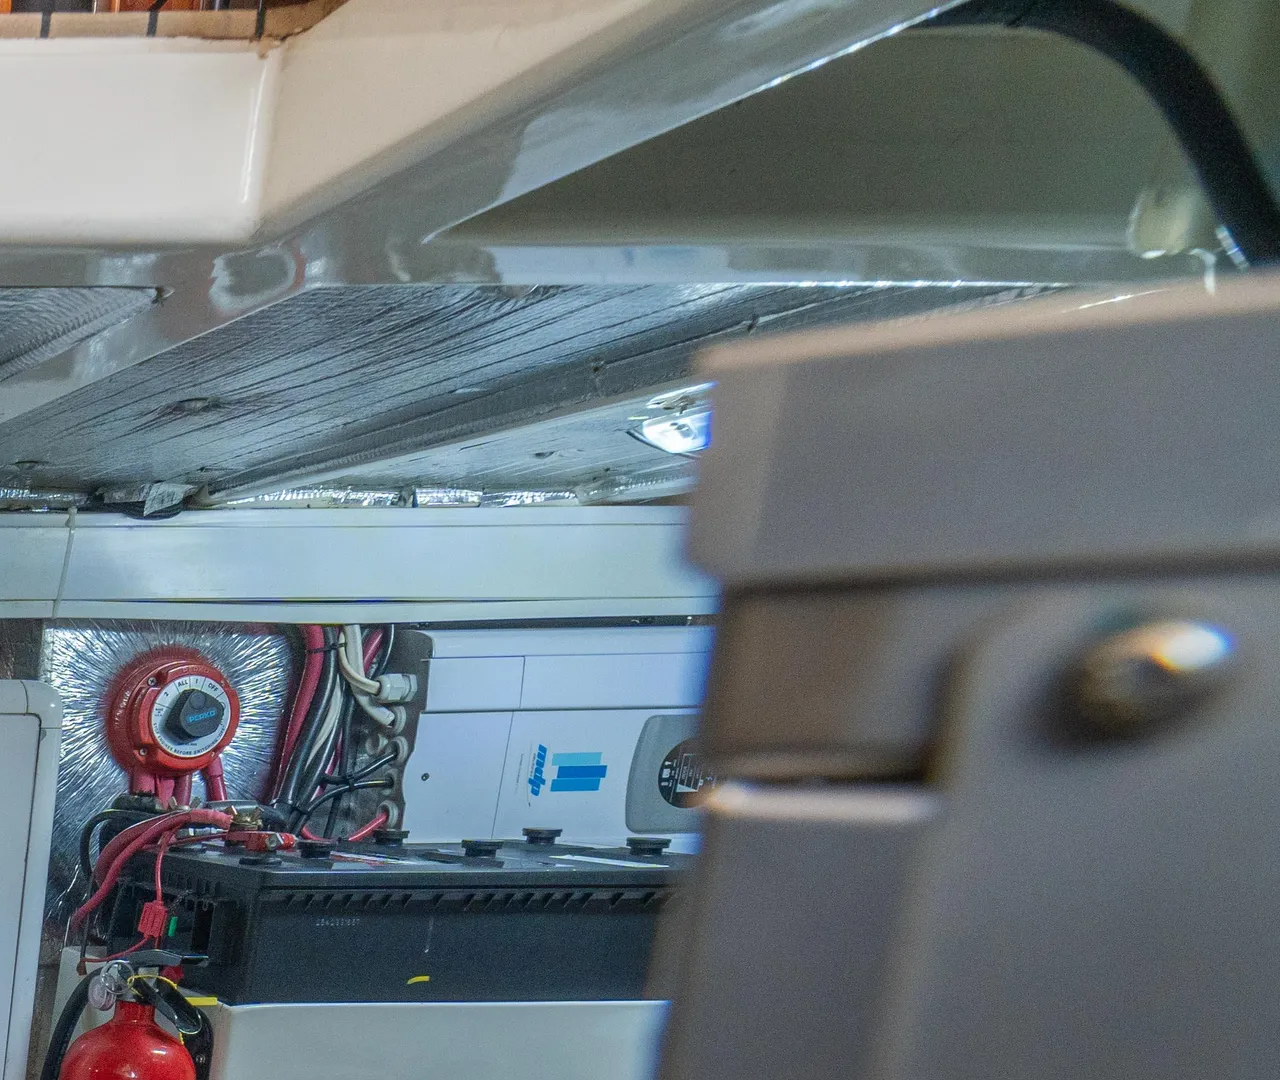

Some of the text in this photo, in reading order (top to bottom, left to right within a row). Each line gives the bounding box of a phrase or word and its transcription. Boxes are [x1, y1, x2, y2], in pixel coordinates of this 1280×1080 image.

[208, 682, 218, 692] OFF
[188, 710, 216, 722] PERKO
[173, 747, 192, 756] BEFORE
